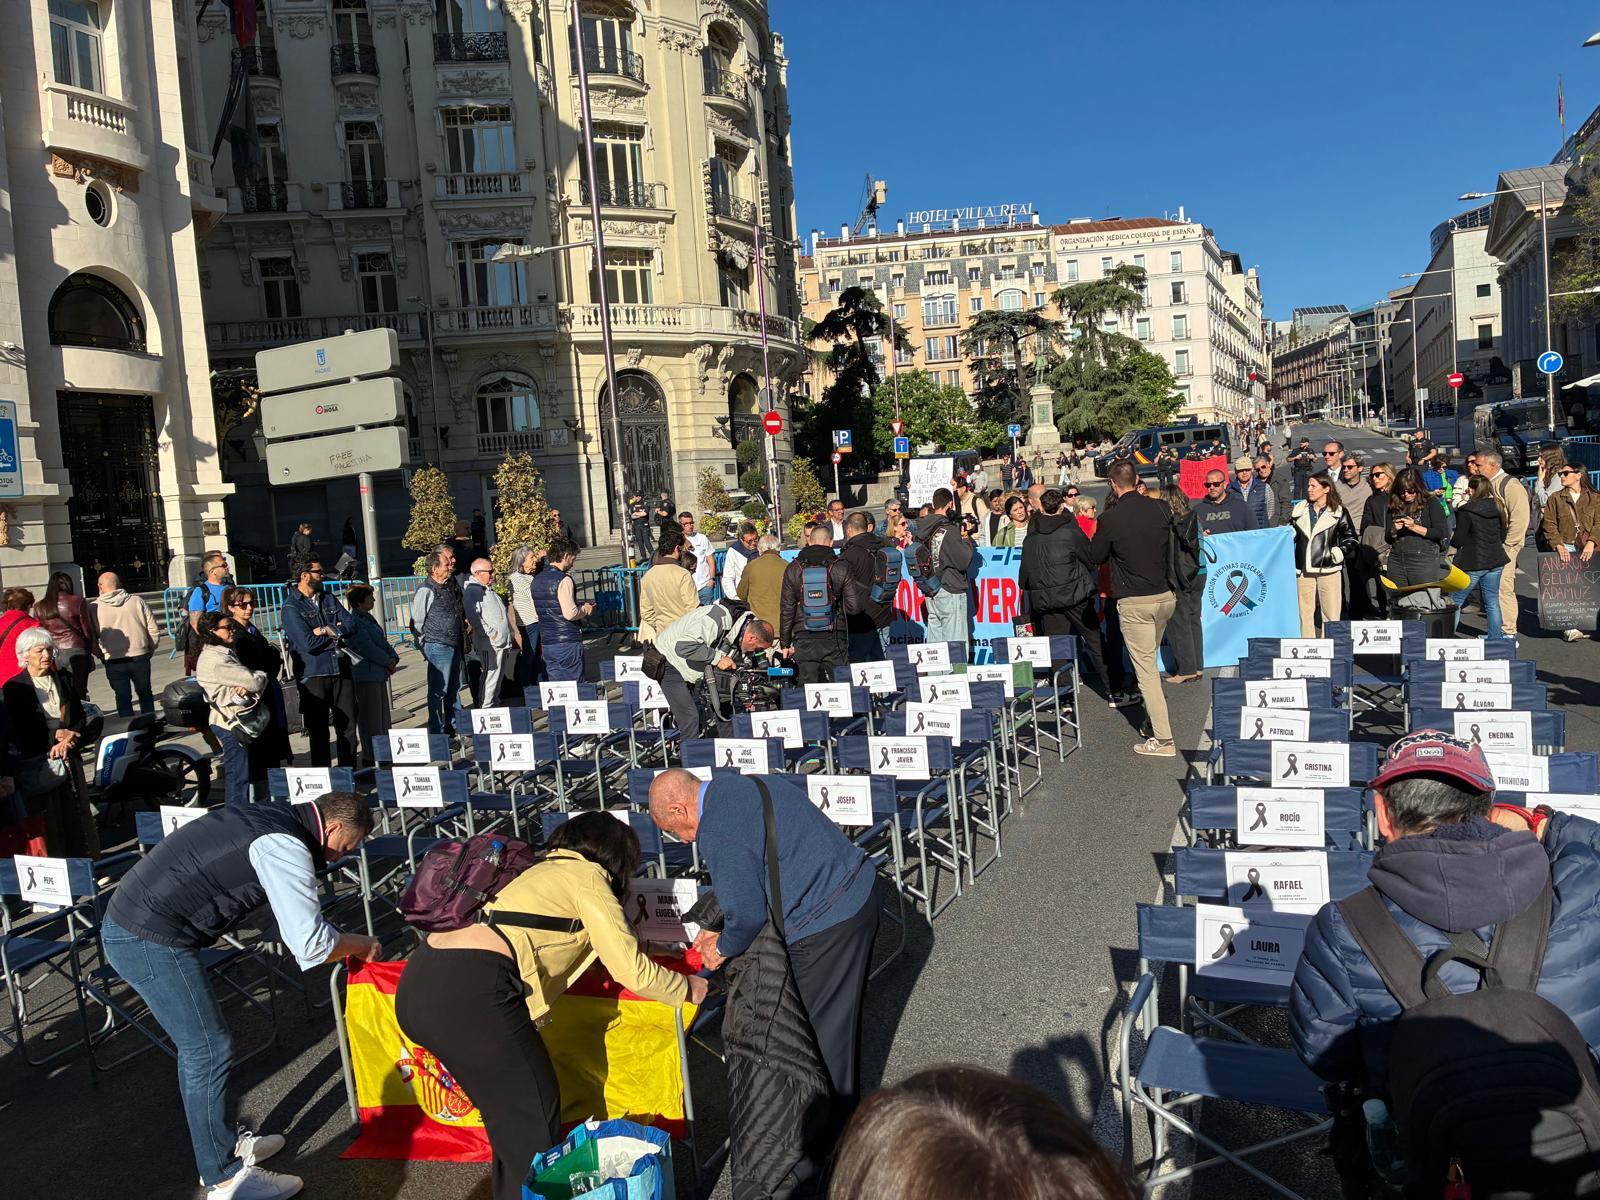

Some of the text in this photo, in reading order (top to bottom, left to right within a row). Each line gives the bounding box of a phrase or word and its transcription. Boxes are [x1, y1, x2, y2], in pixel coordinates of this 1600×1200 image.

[909, 202, 1032, 224] HOTEL VILLA REAL
[1060, 227, 1195, 246] ORGANIZACIÓN MÉDICA COLEGIAL DE ESPAÑA
[840, 431, 849, 445] P
[329, 450, 353, 465] FREE
[334, 455, 372, 472] PALESTINA
[1215, 562, 1239, 578] VÍCTIMAS
[1542, 585, 1593, 600] ADAMUZ
[1228, 610, 1250, 619] ADAMUZ
[1455, 647, 1468, 655] JOSÉ
[1271, 696, 1295, 704] MANUELA
[1473, 700, 1495, 708] ÁLVARO
[927, 721, 950, 729] NATIVIDAD
[1269, 727, 1294, 737] PATRICIA
[1488, 731, 1515, 740] ENEDINA
[891, 747, 917, 755] FRANCISCO
[1418, 748, 1443, 758] 1969
[738, 757, 756, 765] MANUEL
[896, 756, 913, 764] JAVIER
[1304, 763, 1333, 772] CRISTINA
[1498, 776, 1530, 787] TRINIDAD
[836, 796, 856, 805] JOSEFA
[1280, 812, 1301, 823] ROCÍO
[43, 876, 55, 885] PEPE
[1273, 880, 1304, 890] RAFAEL
[1251, 939, 1281, 954] LAURA
